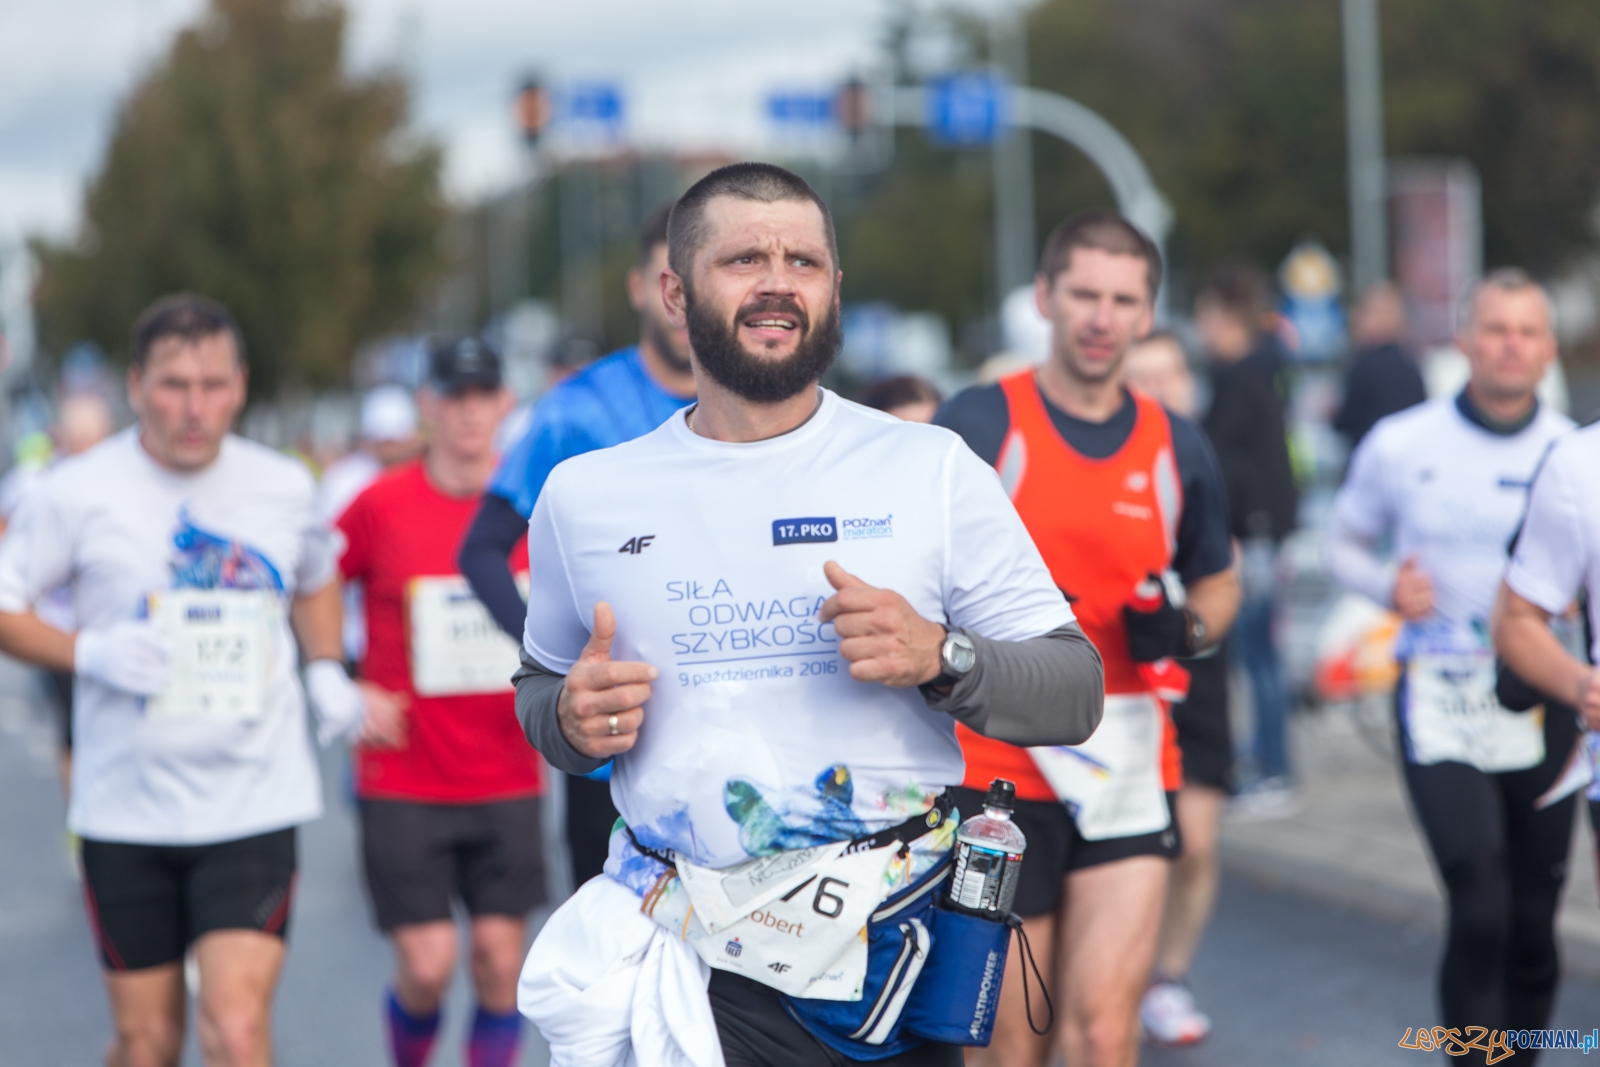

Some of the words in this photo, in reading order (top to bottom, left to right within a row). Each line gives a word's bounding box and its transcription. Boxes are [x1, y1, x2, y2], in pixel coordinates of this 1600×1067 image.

[777, 524, 799, 539] 17.
[800, 523, 833, 537] PKO
[618, 535, 655, 554] 4F
[666, 578, 733, 601] SIŁA
[689, 595, 826, 626] ODWAGA
[678, 672, 690, 687] 9
[799, 659, 839, 676] 2016
[745, 909, 804, 938] obert
[767, 962, 792, 974] 4F
[970, 951, 998, 1041] MULTIPOWER
